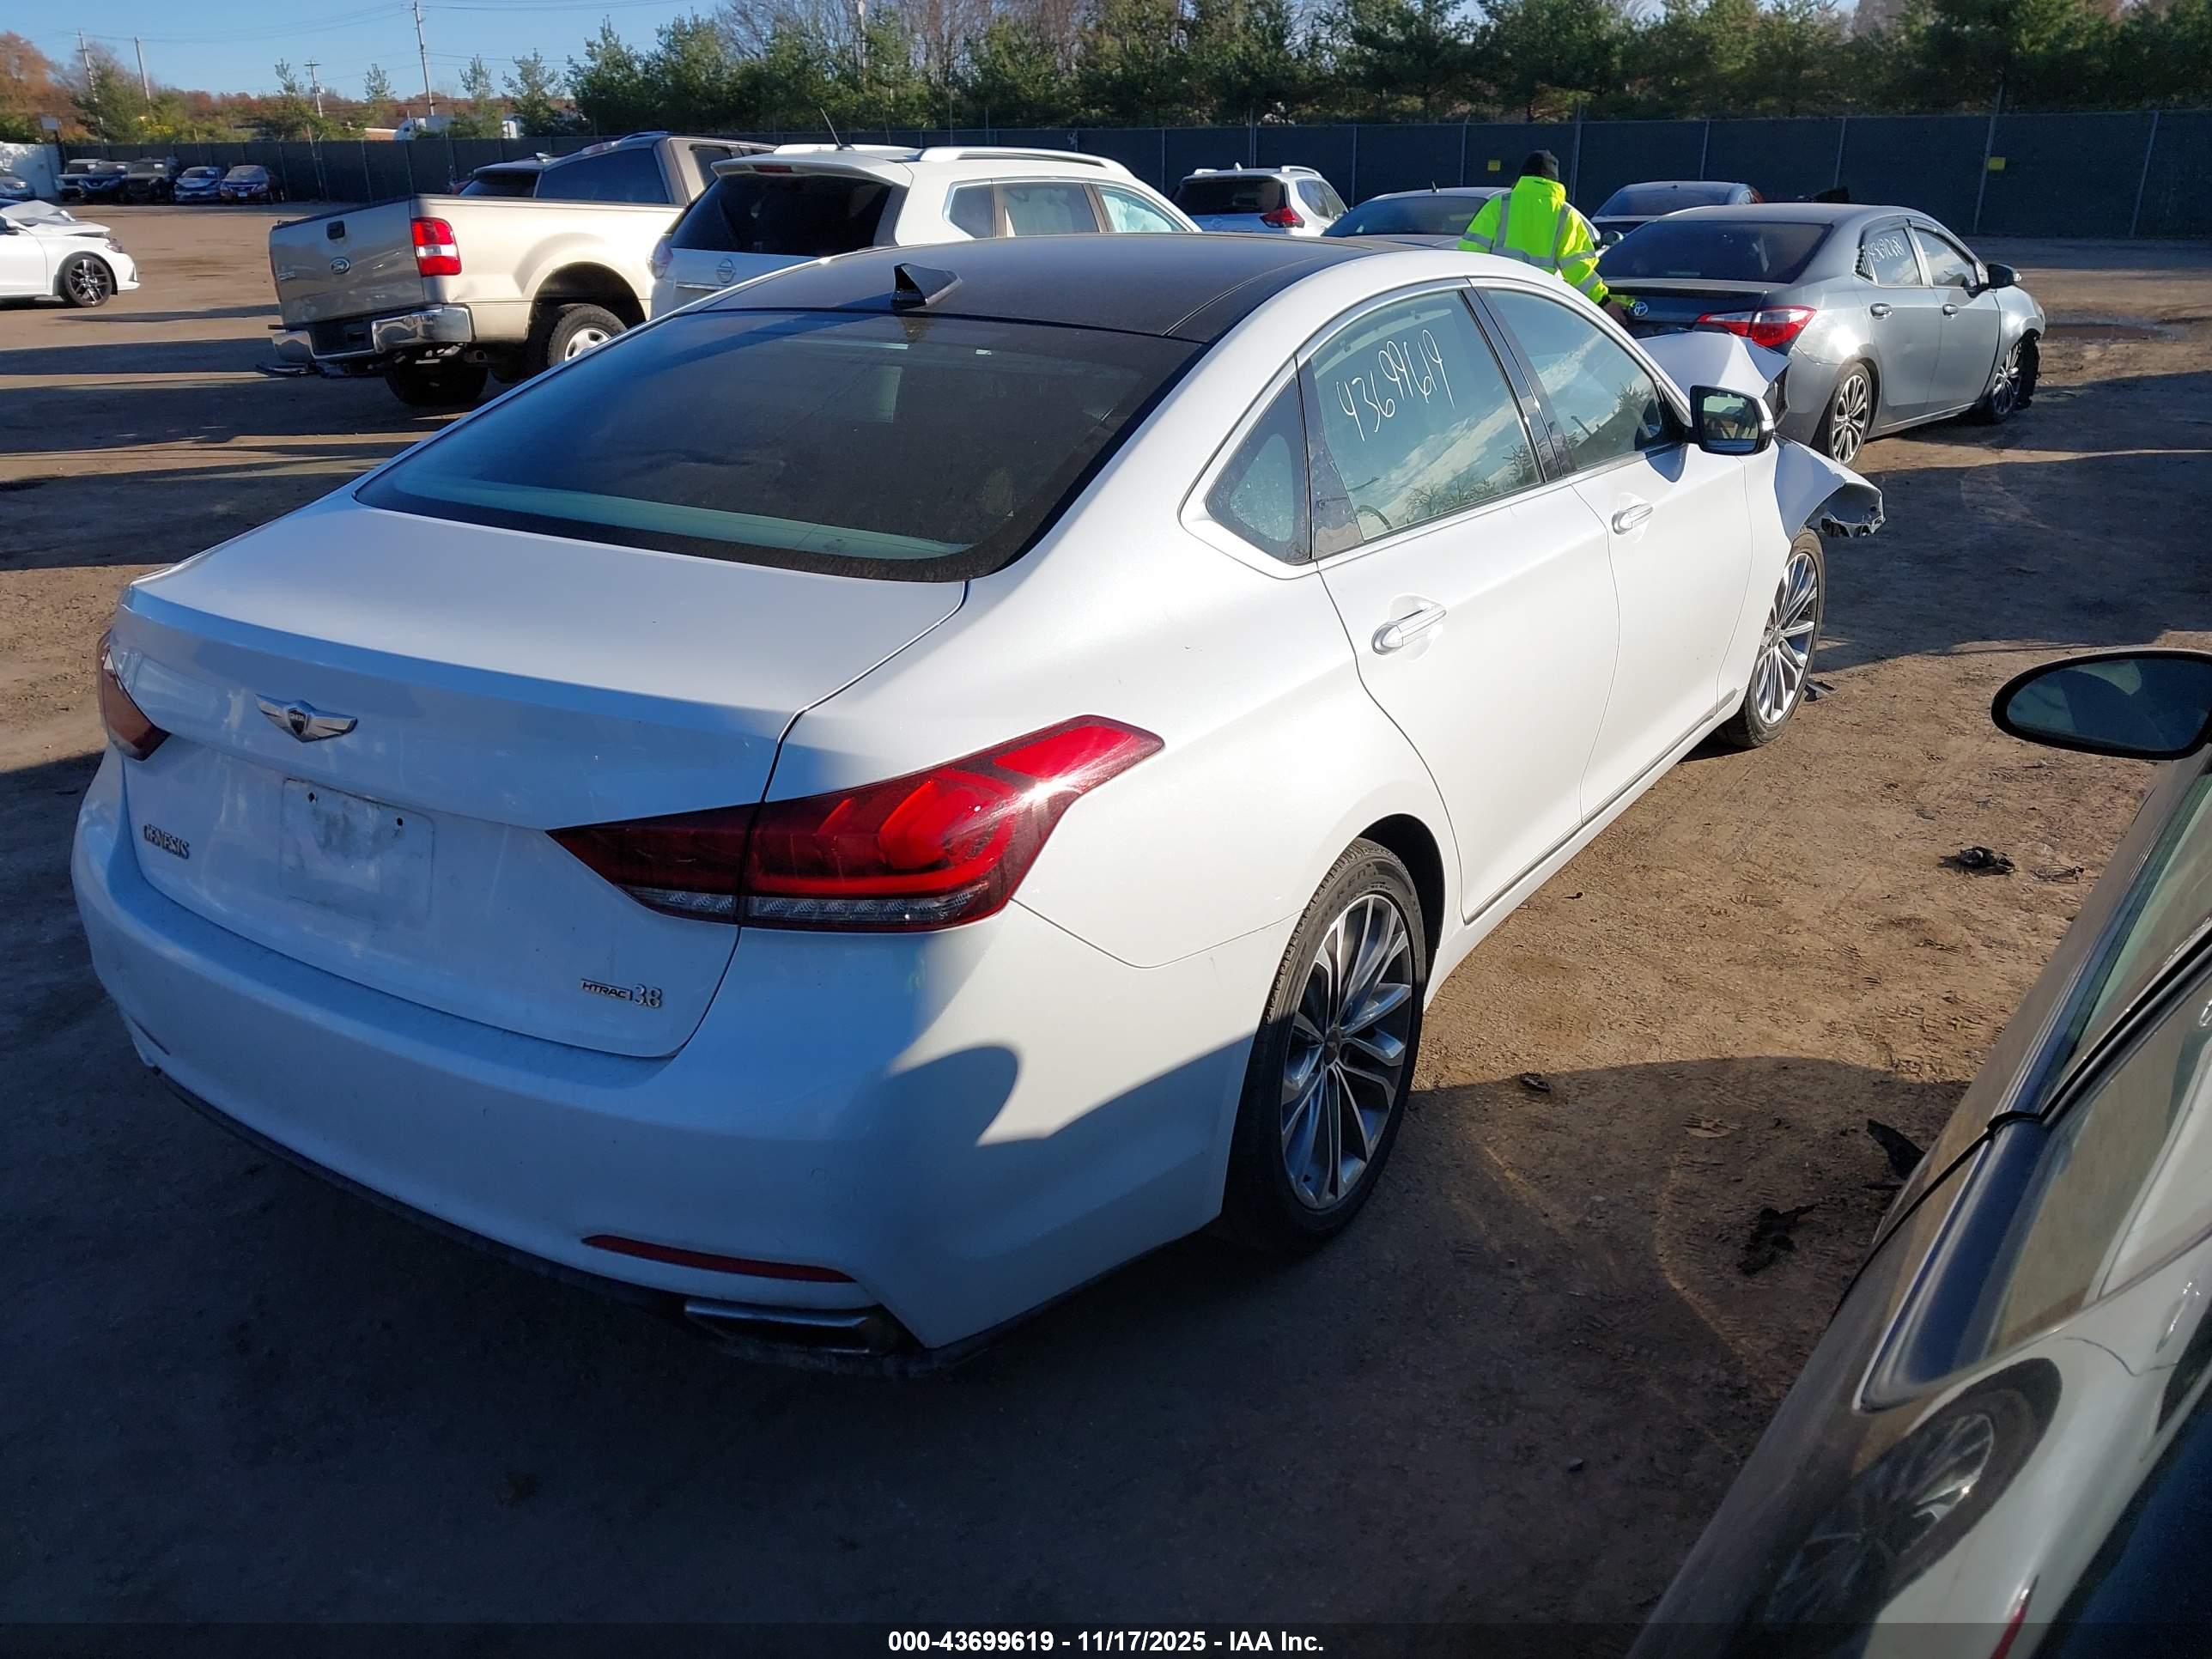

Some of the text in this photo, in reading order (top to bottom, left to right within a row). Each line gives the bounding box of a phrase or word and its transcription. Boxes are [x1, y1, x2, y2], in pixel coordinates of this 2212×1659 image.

[1336, 330, 1455, 441] 43699619
[143, 823, 190, 860] GENESIS
[582, 981, 662, 1008] HTRAC 3.8
